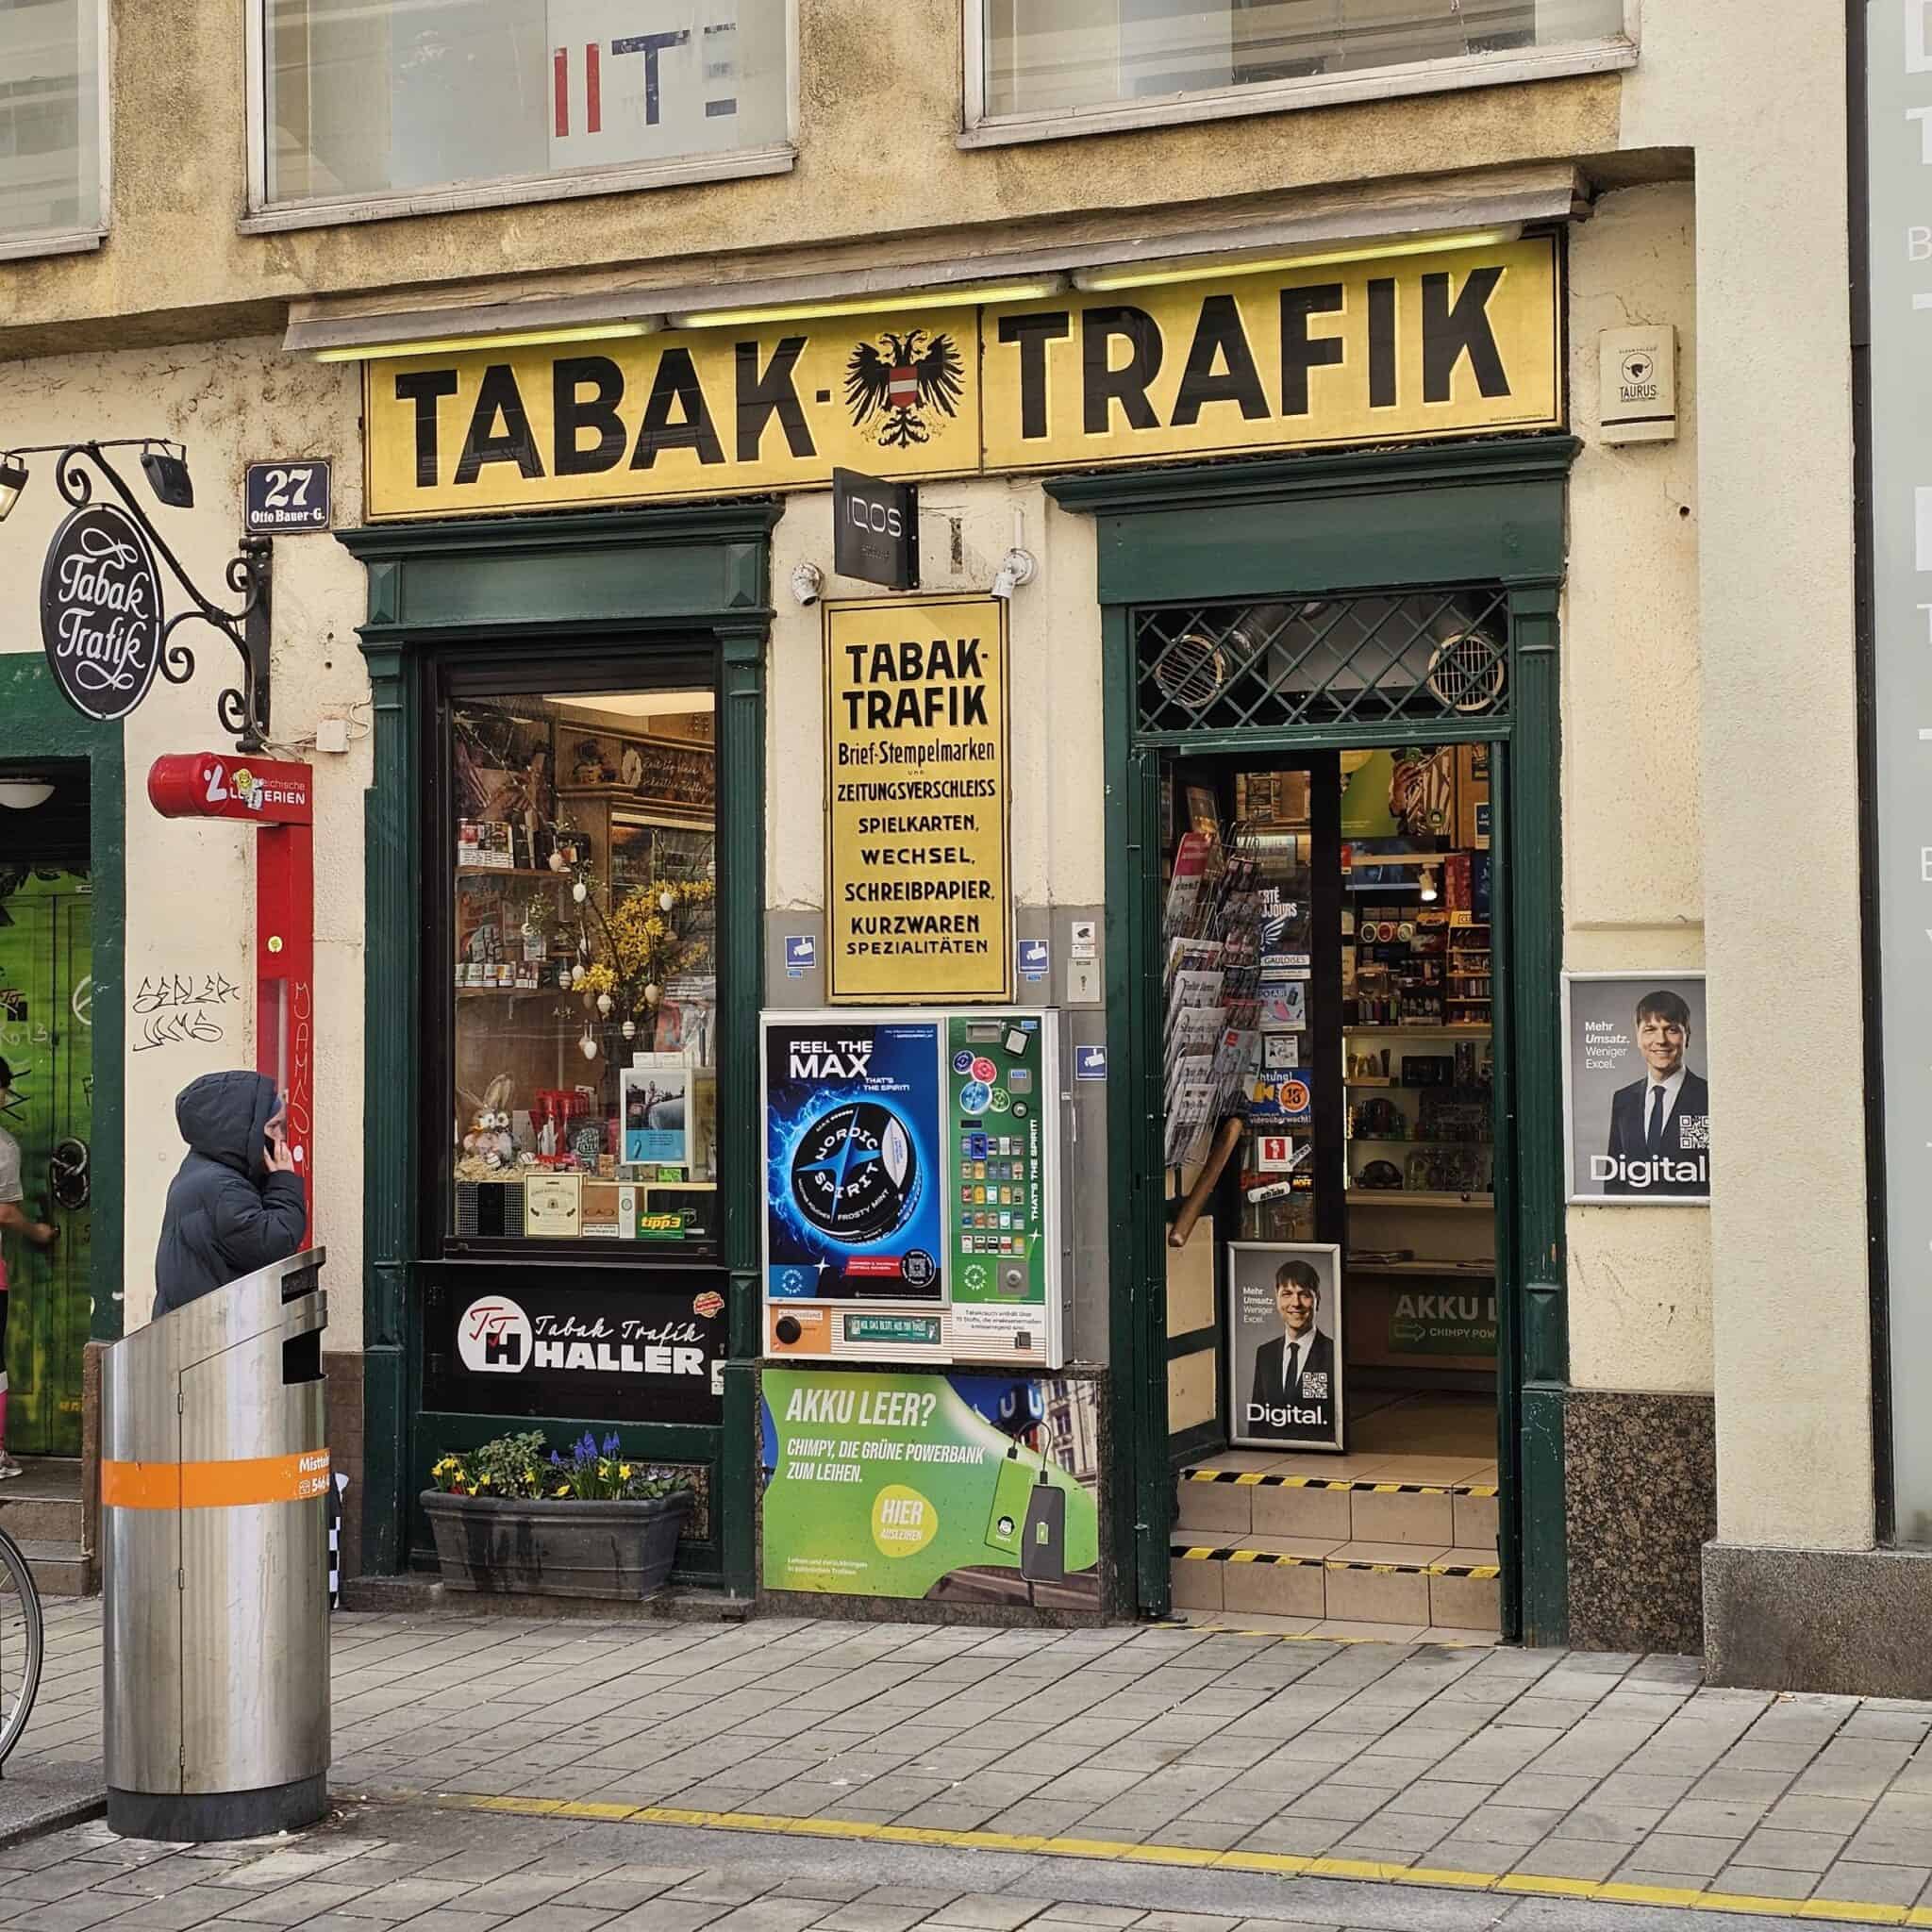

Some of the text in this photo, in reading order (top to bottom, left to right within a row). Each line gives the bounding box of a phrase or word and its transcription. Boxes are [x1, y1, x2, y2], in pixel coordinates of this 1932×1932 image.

[998, 266, 1511, 440] TRAFIK
[1620, 385, 1657, 398] TAURUS
[265, 469, 313, 508] 27
[251, 510, 275, 525] Otto
[847, 496, 902, 538] IQOS
[58, 553, 149, 620] Tabak
[57, 607, 147, 670] Trafik
[842, 685, 989, 730] TRAFIK
[838, 779, 996, 802] ZEITUNGSVERSCHLEISS
[851, 915, 979, 935] KURZWAREN
[846, 937, 988, 956] SPEZIALITÄTEN
[1585, 1021, 1614, 1032] Mehr
[790, 1041, 874, 1054] FEEL THE
[1585, 1034, 1630, 1044] Umsatz.
[1585, 1046, 1627, 1058] Weniger
[1585, 1058, 1616, 1070] Excel.
[790, 1054, 871, 1078] MAX
[815, 1126, 878, 1160] NORDIC
[814, 1162, 878, 1199] SPIRIT
[641, 1215, 681, 1230] tipp3
[1242, 1286, 1264, 1295] Mehr
[1394, 1294, 1479, 1321] AKKU
[535, 1315, 705, 1346] Tabak Trafik
[1429, 1327, 1471, 1338] CHIMPY
[534, 1341, 705, 1375] HALLER
[785, 1388, 938, 1428] AKKU LEER?
[1246, 1403, 1328, 1427] Digital.
[787, 1438, 986, 1465] CHIMPY, DIE GRÜNE POWERBANK
[786, 1462, 863, 1484] ZUM LEIHEN.
[879, 1499, 924, 1525] HIER
